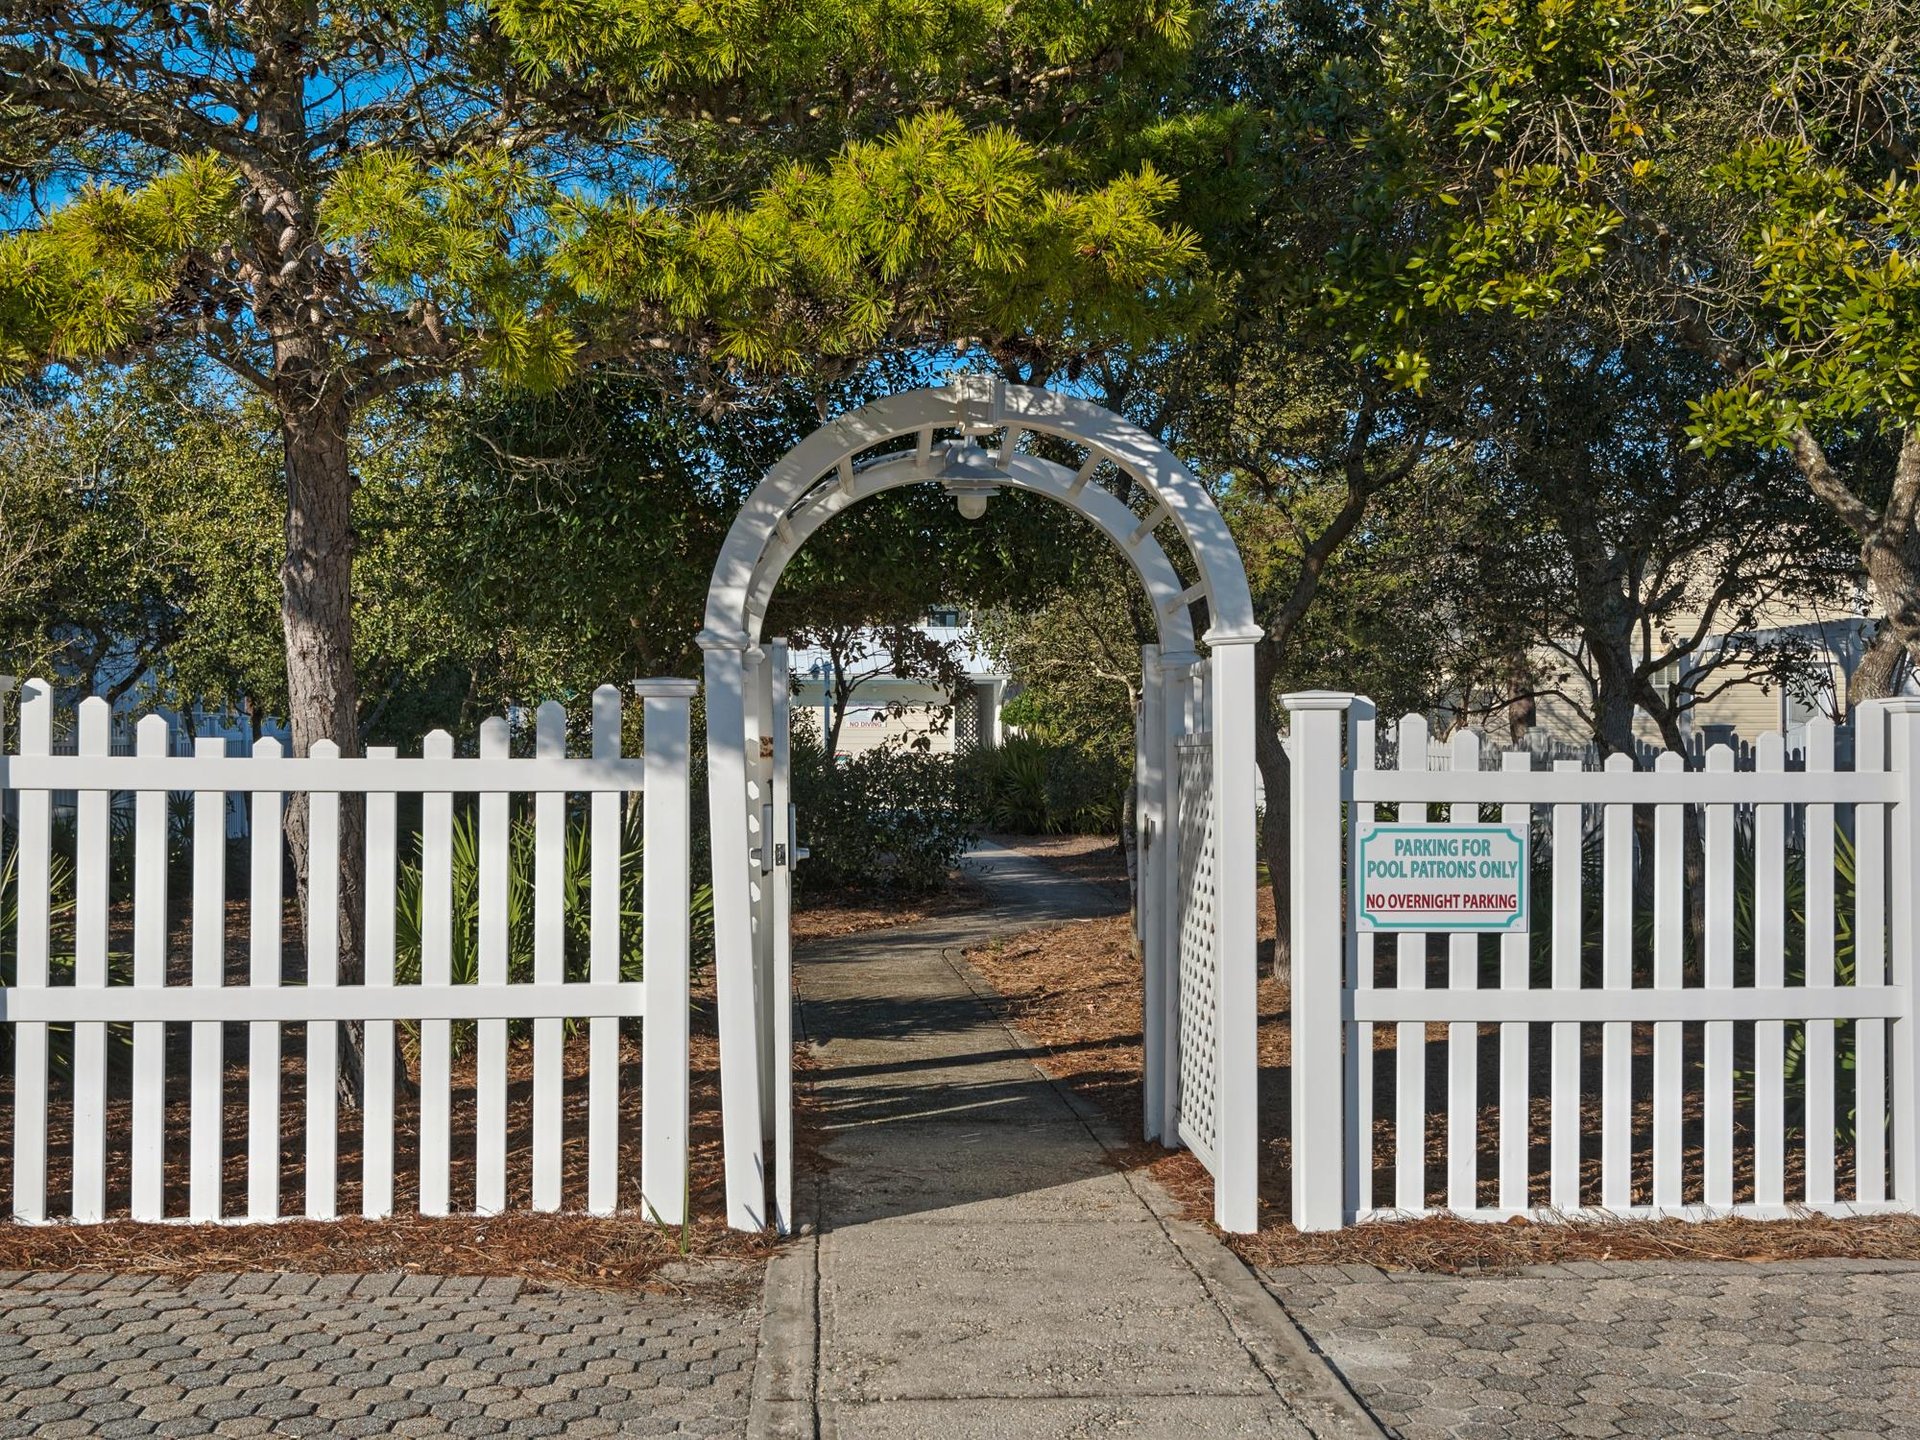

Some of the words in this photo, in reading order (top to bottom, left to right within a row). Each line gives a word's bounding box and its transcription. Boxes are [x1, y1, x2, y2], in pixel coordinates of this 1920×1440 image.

[1394, 838, 1458, 857] PARKING
[1461, 838, 1491, 857] FOR
[1367, 860, 1408, 879] POOL
[1411, 860, 1476, 879] PATRONS
[1479, 860, 1518, 879] ONLY
[1366, 894, 1385, 909] NO
[1388, 894, 1460, 909] OVERNIGHT
[1463, 894, 1517, 909] PARKING
